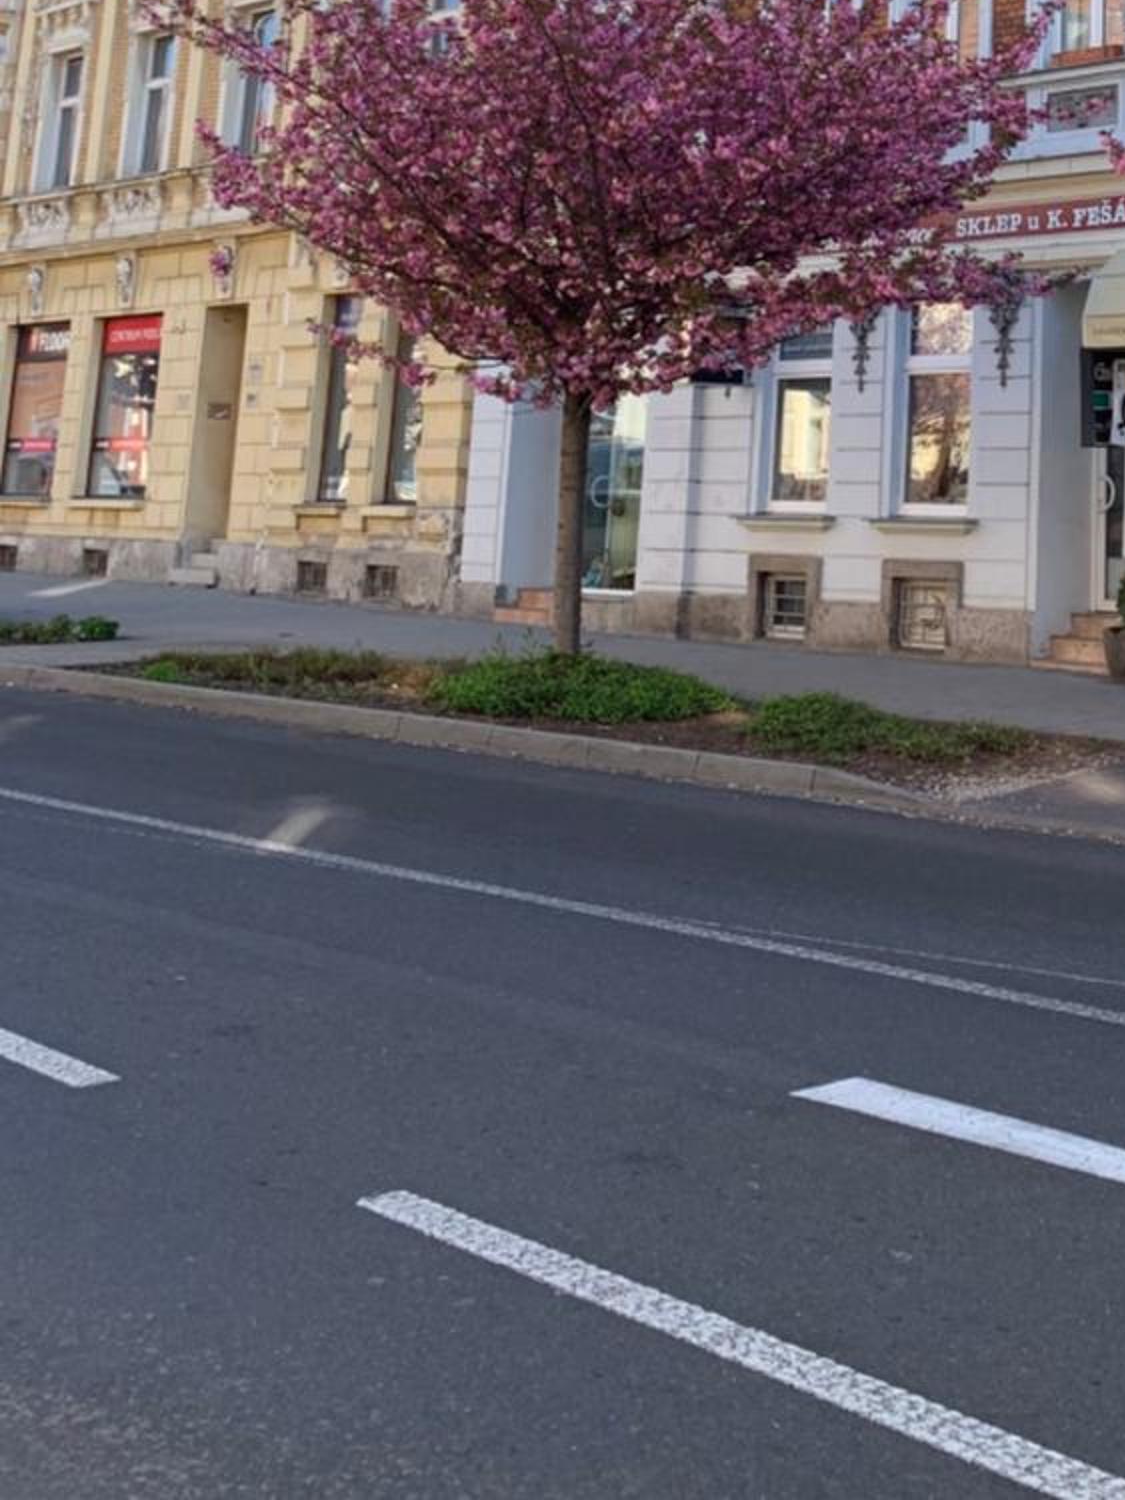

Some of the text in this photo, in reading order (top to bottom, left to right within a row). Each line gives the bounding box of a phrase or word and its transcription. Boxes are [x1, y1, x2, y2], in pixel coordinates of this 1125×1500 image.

[956, 213, 1022, 237] SKLEP
[1028, 215, 1040, 230] u
[1046, 211, 1069, 229] K.
